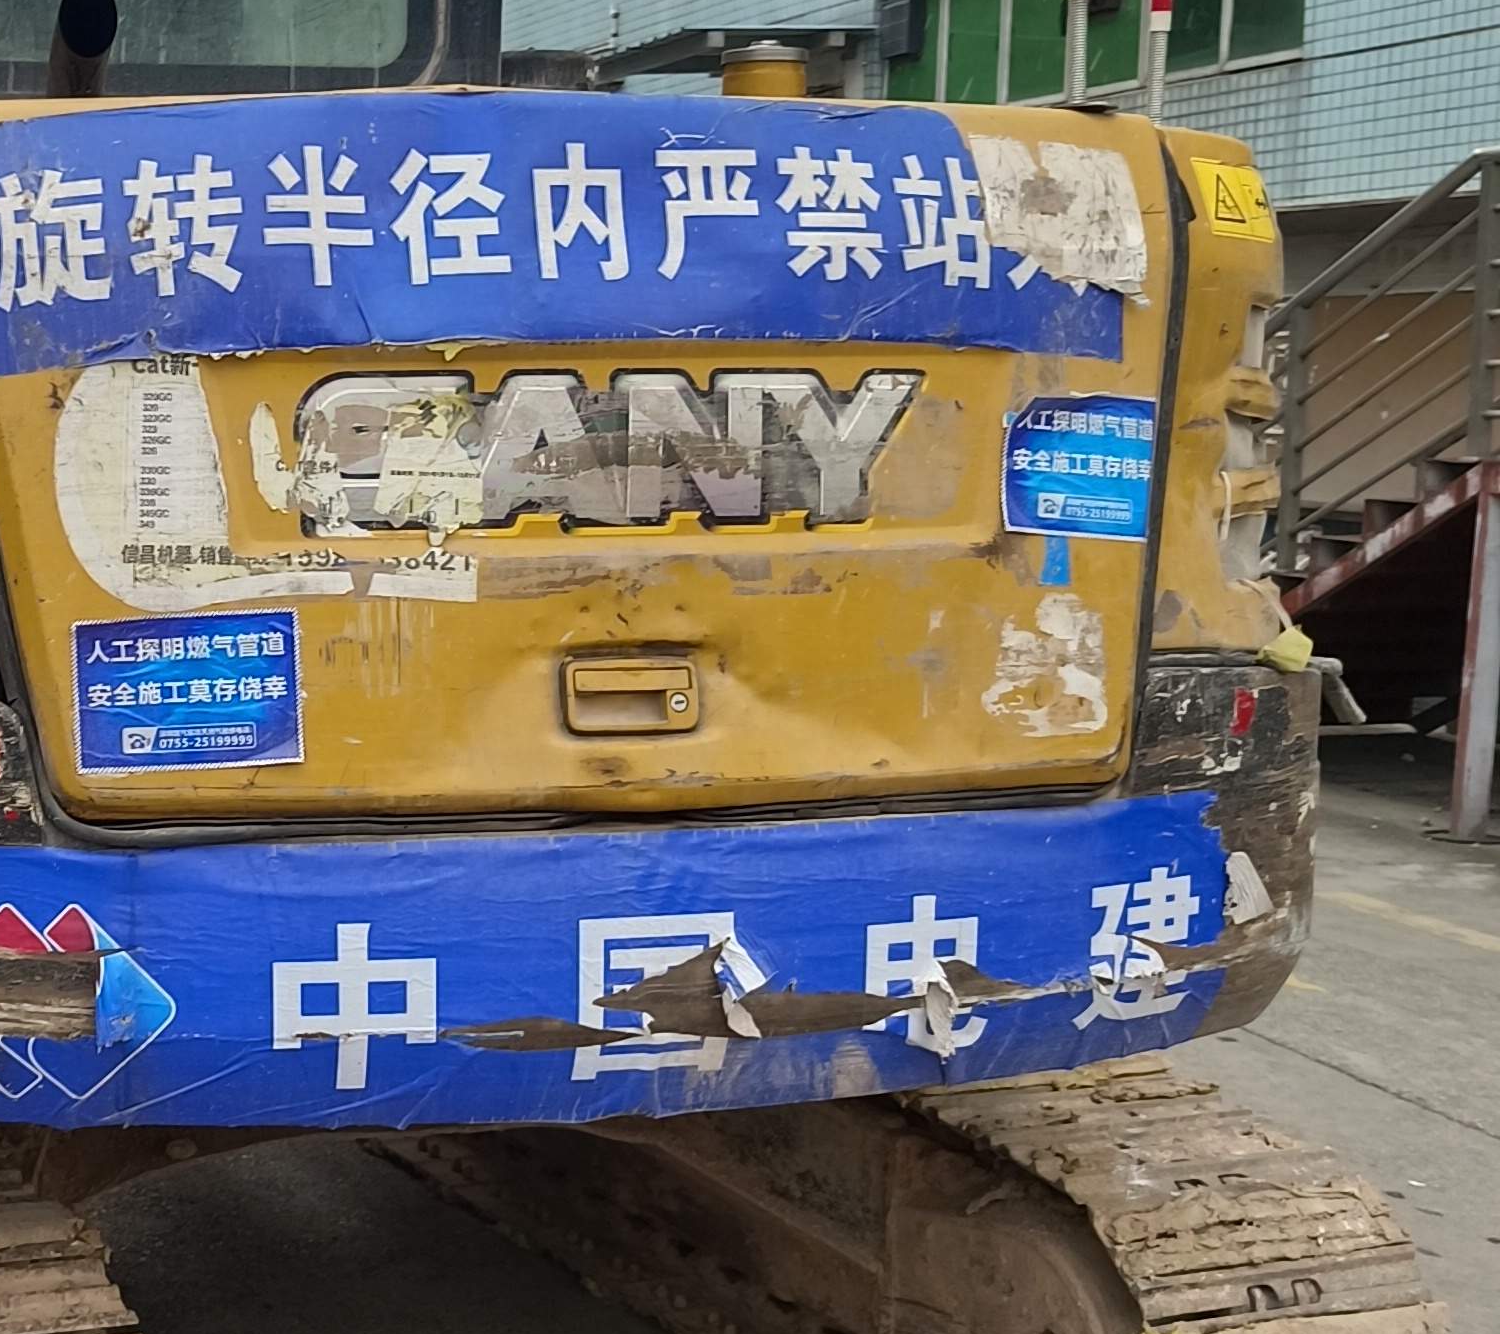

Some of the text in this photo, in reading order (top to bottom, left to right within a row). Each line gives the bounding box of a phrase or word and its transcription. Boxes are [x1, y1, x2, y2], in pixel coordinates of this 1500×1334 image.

[86, 631, 286, 664] 人工探明燃气管道
[87, 675, 288, 708] 安全施工莫存侥幸
[159, 734, 254, 749] 0755-25199999
